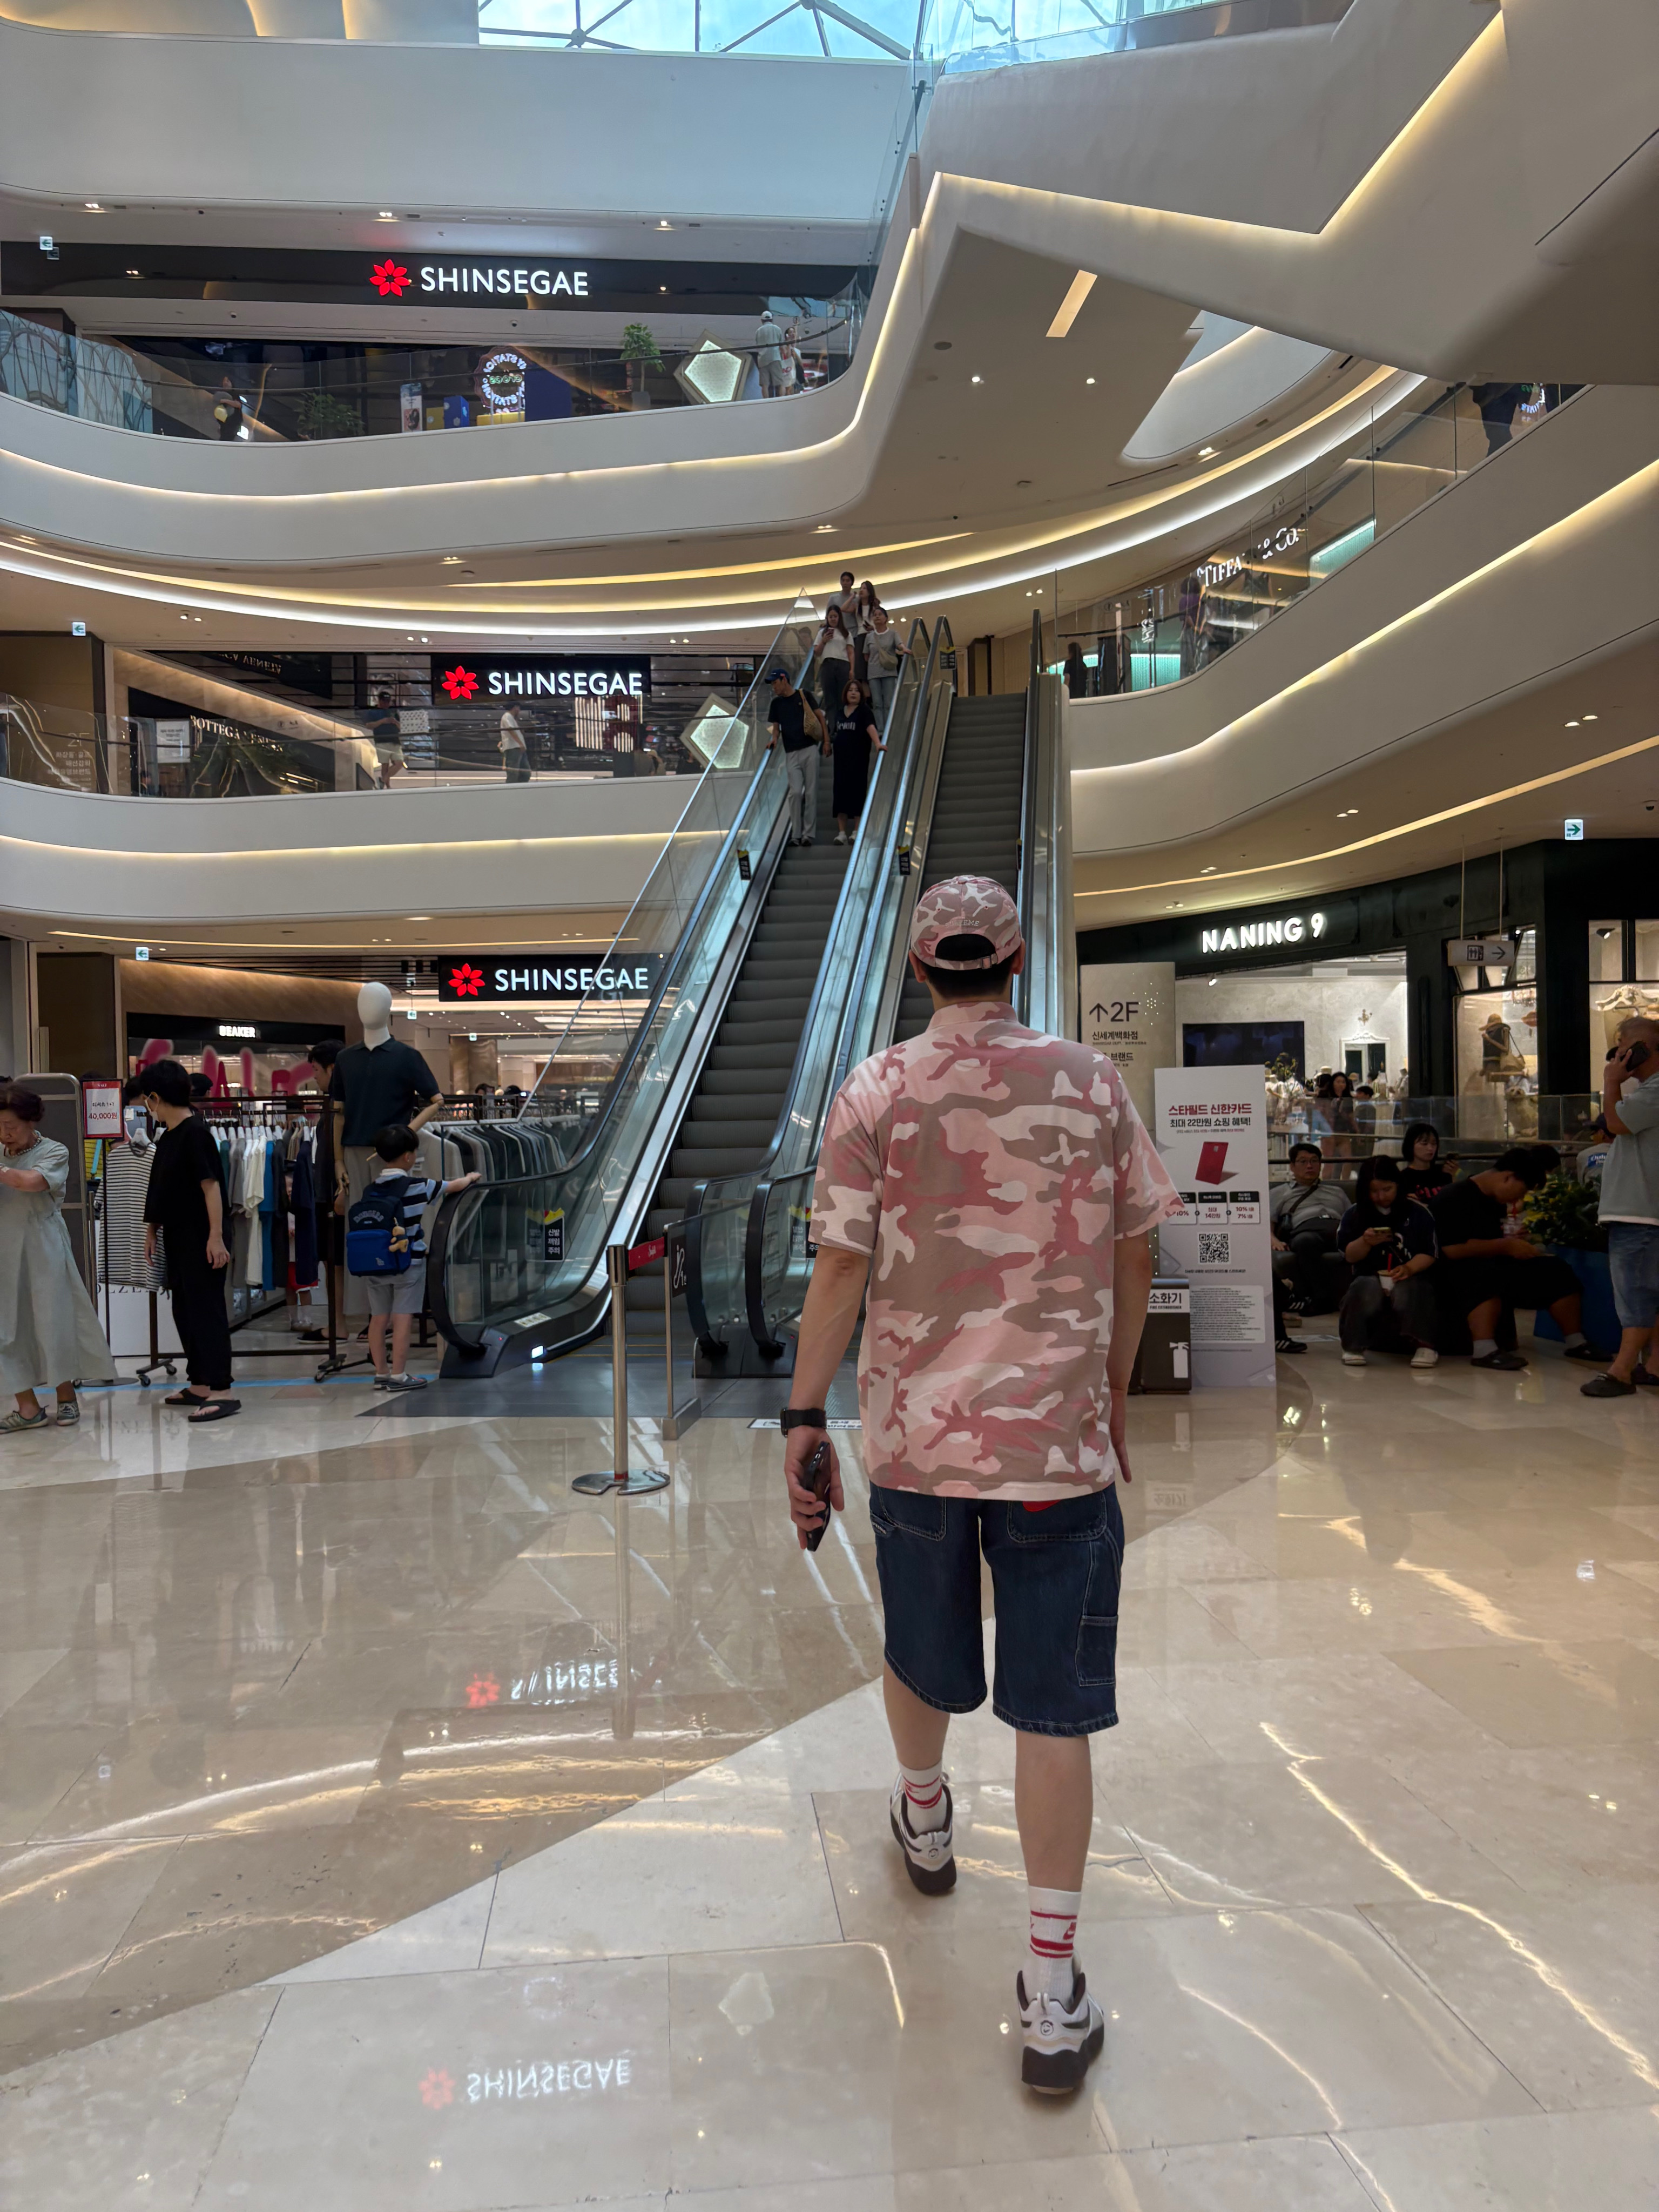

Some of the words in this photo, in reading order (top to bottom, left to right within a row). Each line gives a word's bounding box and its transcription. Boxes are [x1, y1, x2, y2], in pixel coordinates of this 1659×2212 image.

[421, 267, 589, 296] SHINSEGAE
[488, 672, 643, 696] SHINSEGAE
[1201, 916, 1303, 953] NANING
[1311, 913, 1325, 938] 9
[495, 968, 648, 992] SHINSEGAE
[1110, 1001, 1139, 1022] 2F
[219, 1025, 255, 1038] BEAKER
[1092, 1030, 1138, 1040] 신세계백화점
[1110, 1051, 1134, 1062] 브랜드
[1169, 1104, 1208, 1116] 스타필드
[1211, 1103, 1252, 1115] 신한카드
[88, 1112, 118, 1121] 40,000원
[1170, 1119, 1185, 1128] 최대
[1187, 1118, 1211, 1127] 22만원
[1213, 1117, 1230, 1127] 쇼핑
[1232, 1117, 1251, 1126] 혜택!
[548, 1229, 560, 1237] 신발
[548, 1246, 560, 1255] 주의
[1149, 1292, 1182, 1304] 소화기
